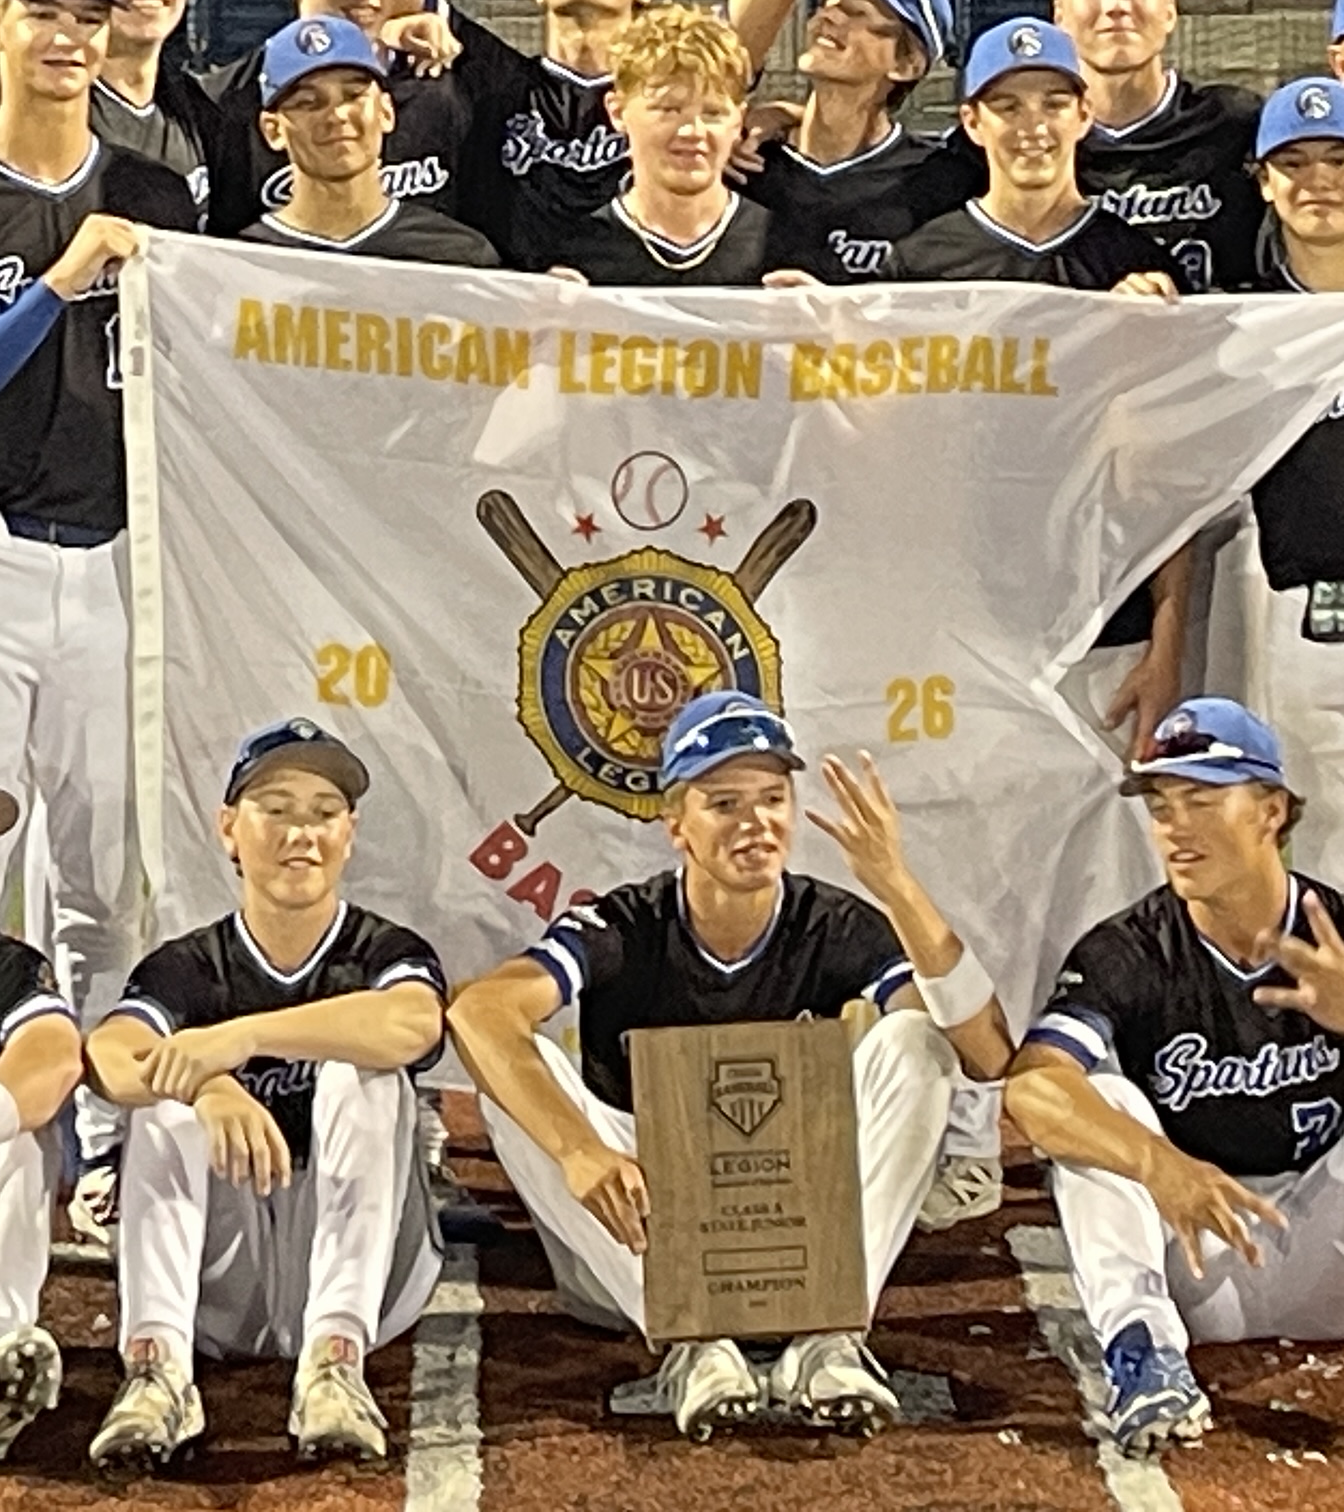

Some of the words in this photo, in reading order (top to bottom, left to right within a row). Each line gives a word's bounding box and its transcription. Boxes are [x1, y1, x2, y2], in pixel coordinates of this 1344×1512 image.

[234, 298, 531, 389] AMERICAN
[558, 331, 762, 399] LEGION
[789, 336, 1059, 402] BASEBALL
[555, 577, 751, 661] AMERICAN
[315, 644, 391, 707] 20
[632, 666, 674, 704] US
[886, 676, 956, 743] 26
[1151, 1033, 1340, 1112] Spartans
[1292, 1096, 1342, 1161] 7
[711, 1155, 791, 1175] LEGION
[707, 1276, 806, 1296] CHAMPION
